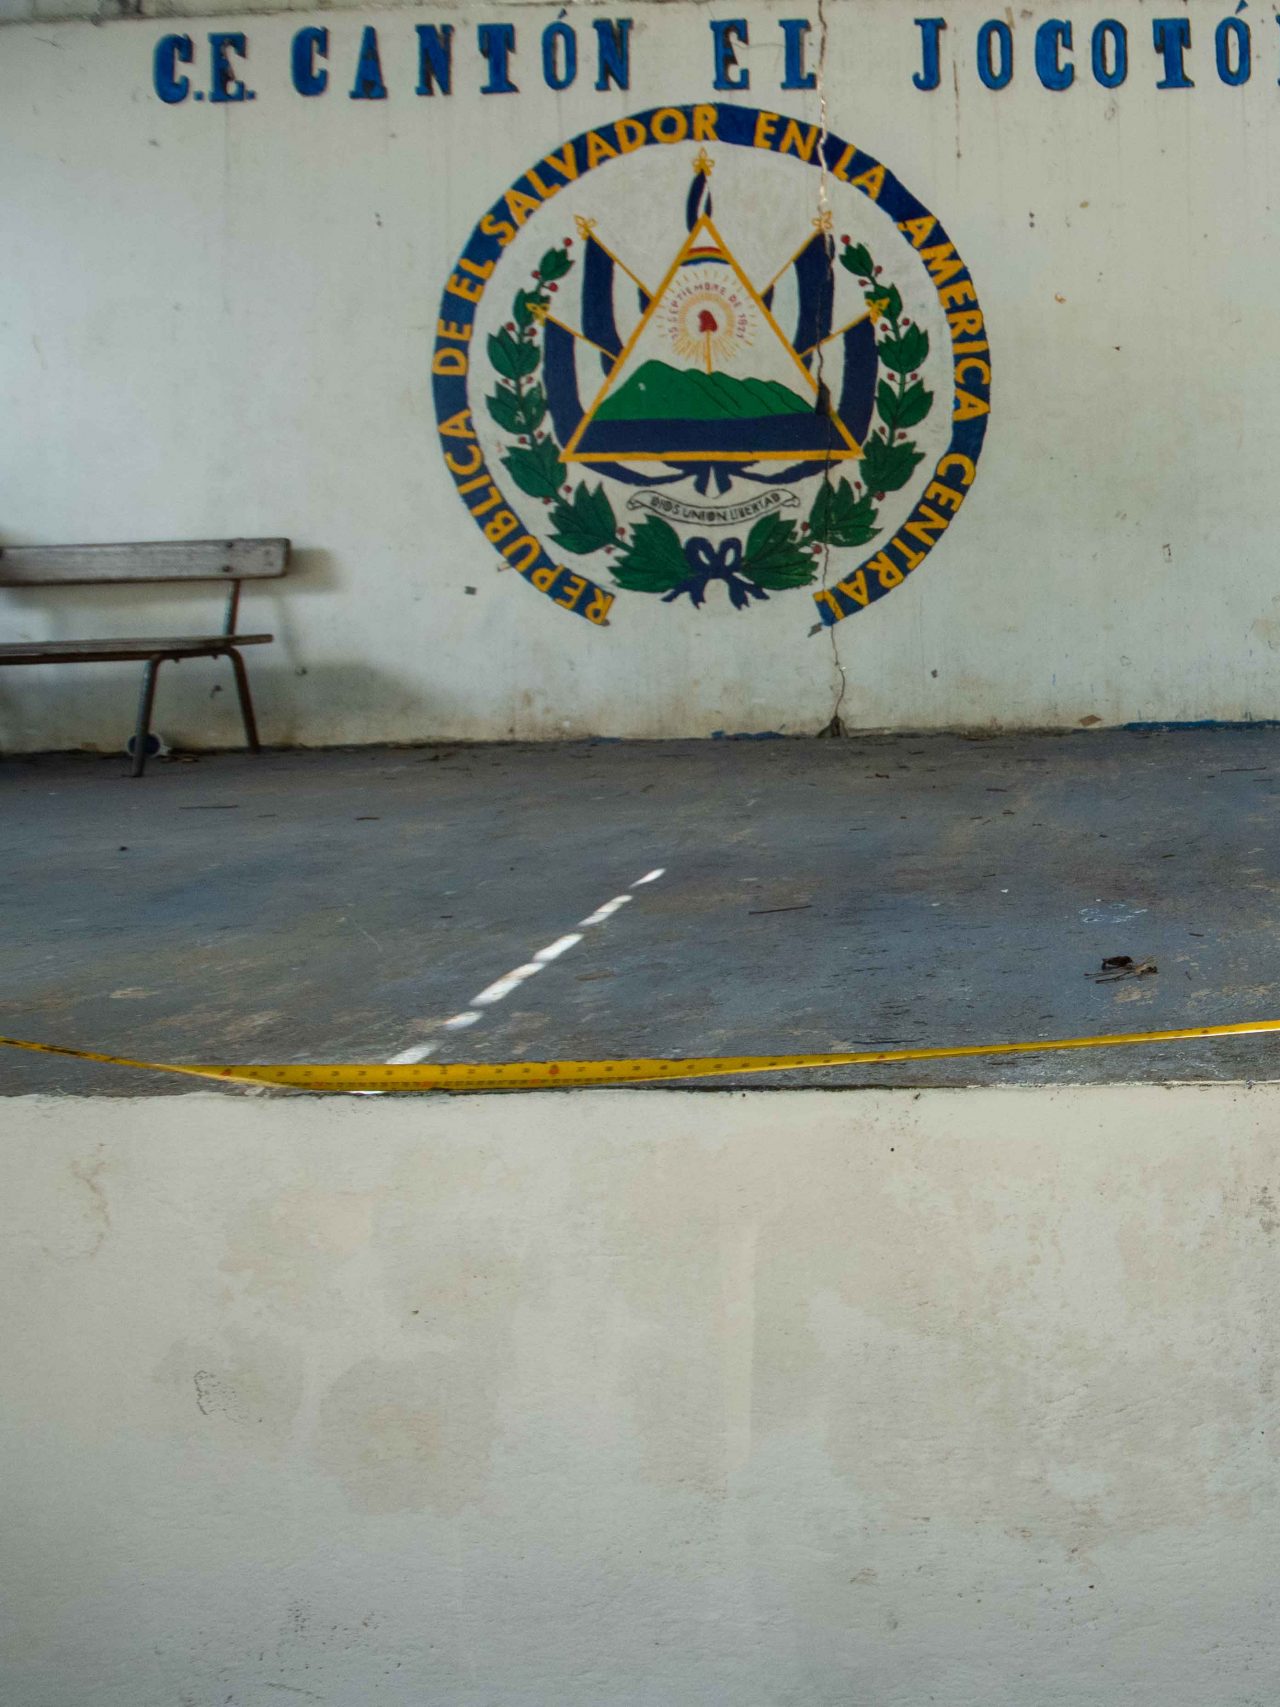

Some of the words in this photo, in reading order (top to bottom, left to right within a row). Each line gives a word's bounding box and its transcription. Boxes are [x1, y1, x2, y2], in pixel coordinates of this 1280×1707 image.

[290, 8, 632, 99] CANTÓN
[709, 18, 818, 90] EL
[753, 110, 820, 162] EN
[832, 143, 886, 201] LA
[479, 103, 719, 247] SALVADOR
[446, 258, 497, 304] EL
[897, 214, 981, 422] AMERICA
[432, 318, 474, 376] DE
[437, 408, 616, 625] REPUBLICA
[682, 508, 728, 522] UNION
[812, 453, 976, 621] CENTRAL
